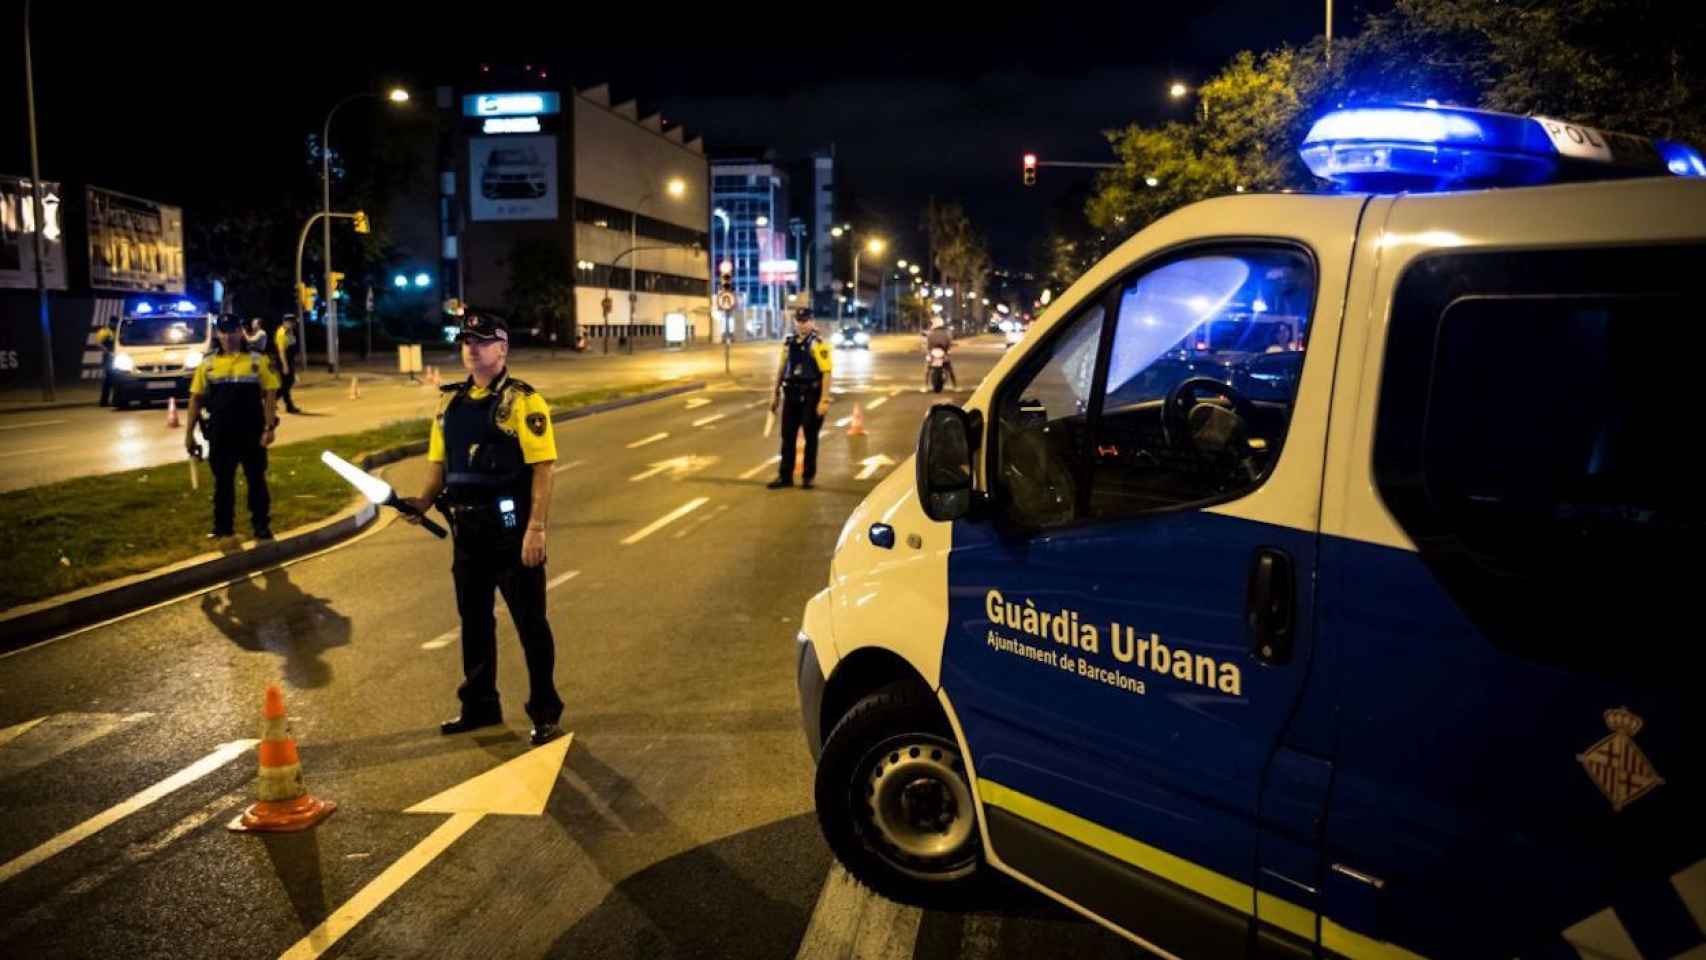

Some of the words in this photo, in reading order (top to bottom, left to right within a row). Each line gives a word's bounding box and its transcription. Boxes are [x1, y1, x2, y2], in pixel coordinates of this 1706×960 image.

[985, 589, 1099, 654] Guàrdia
[1111, 622, 1242, 696] Urbana
[987, 630, 1058, 667] Ajuntament
[1059, 653, 1075, 673] de
[1077, 658, 1146, 695] Barcelona
